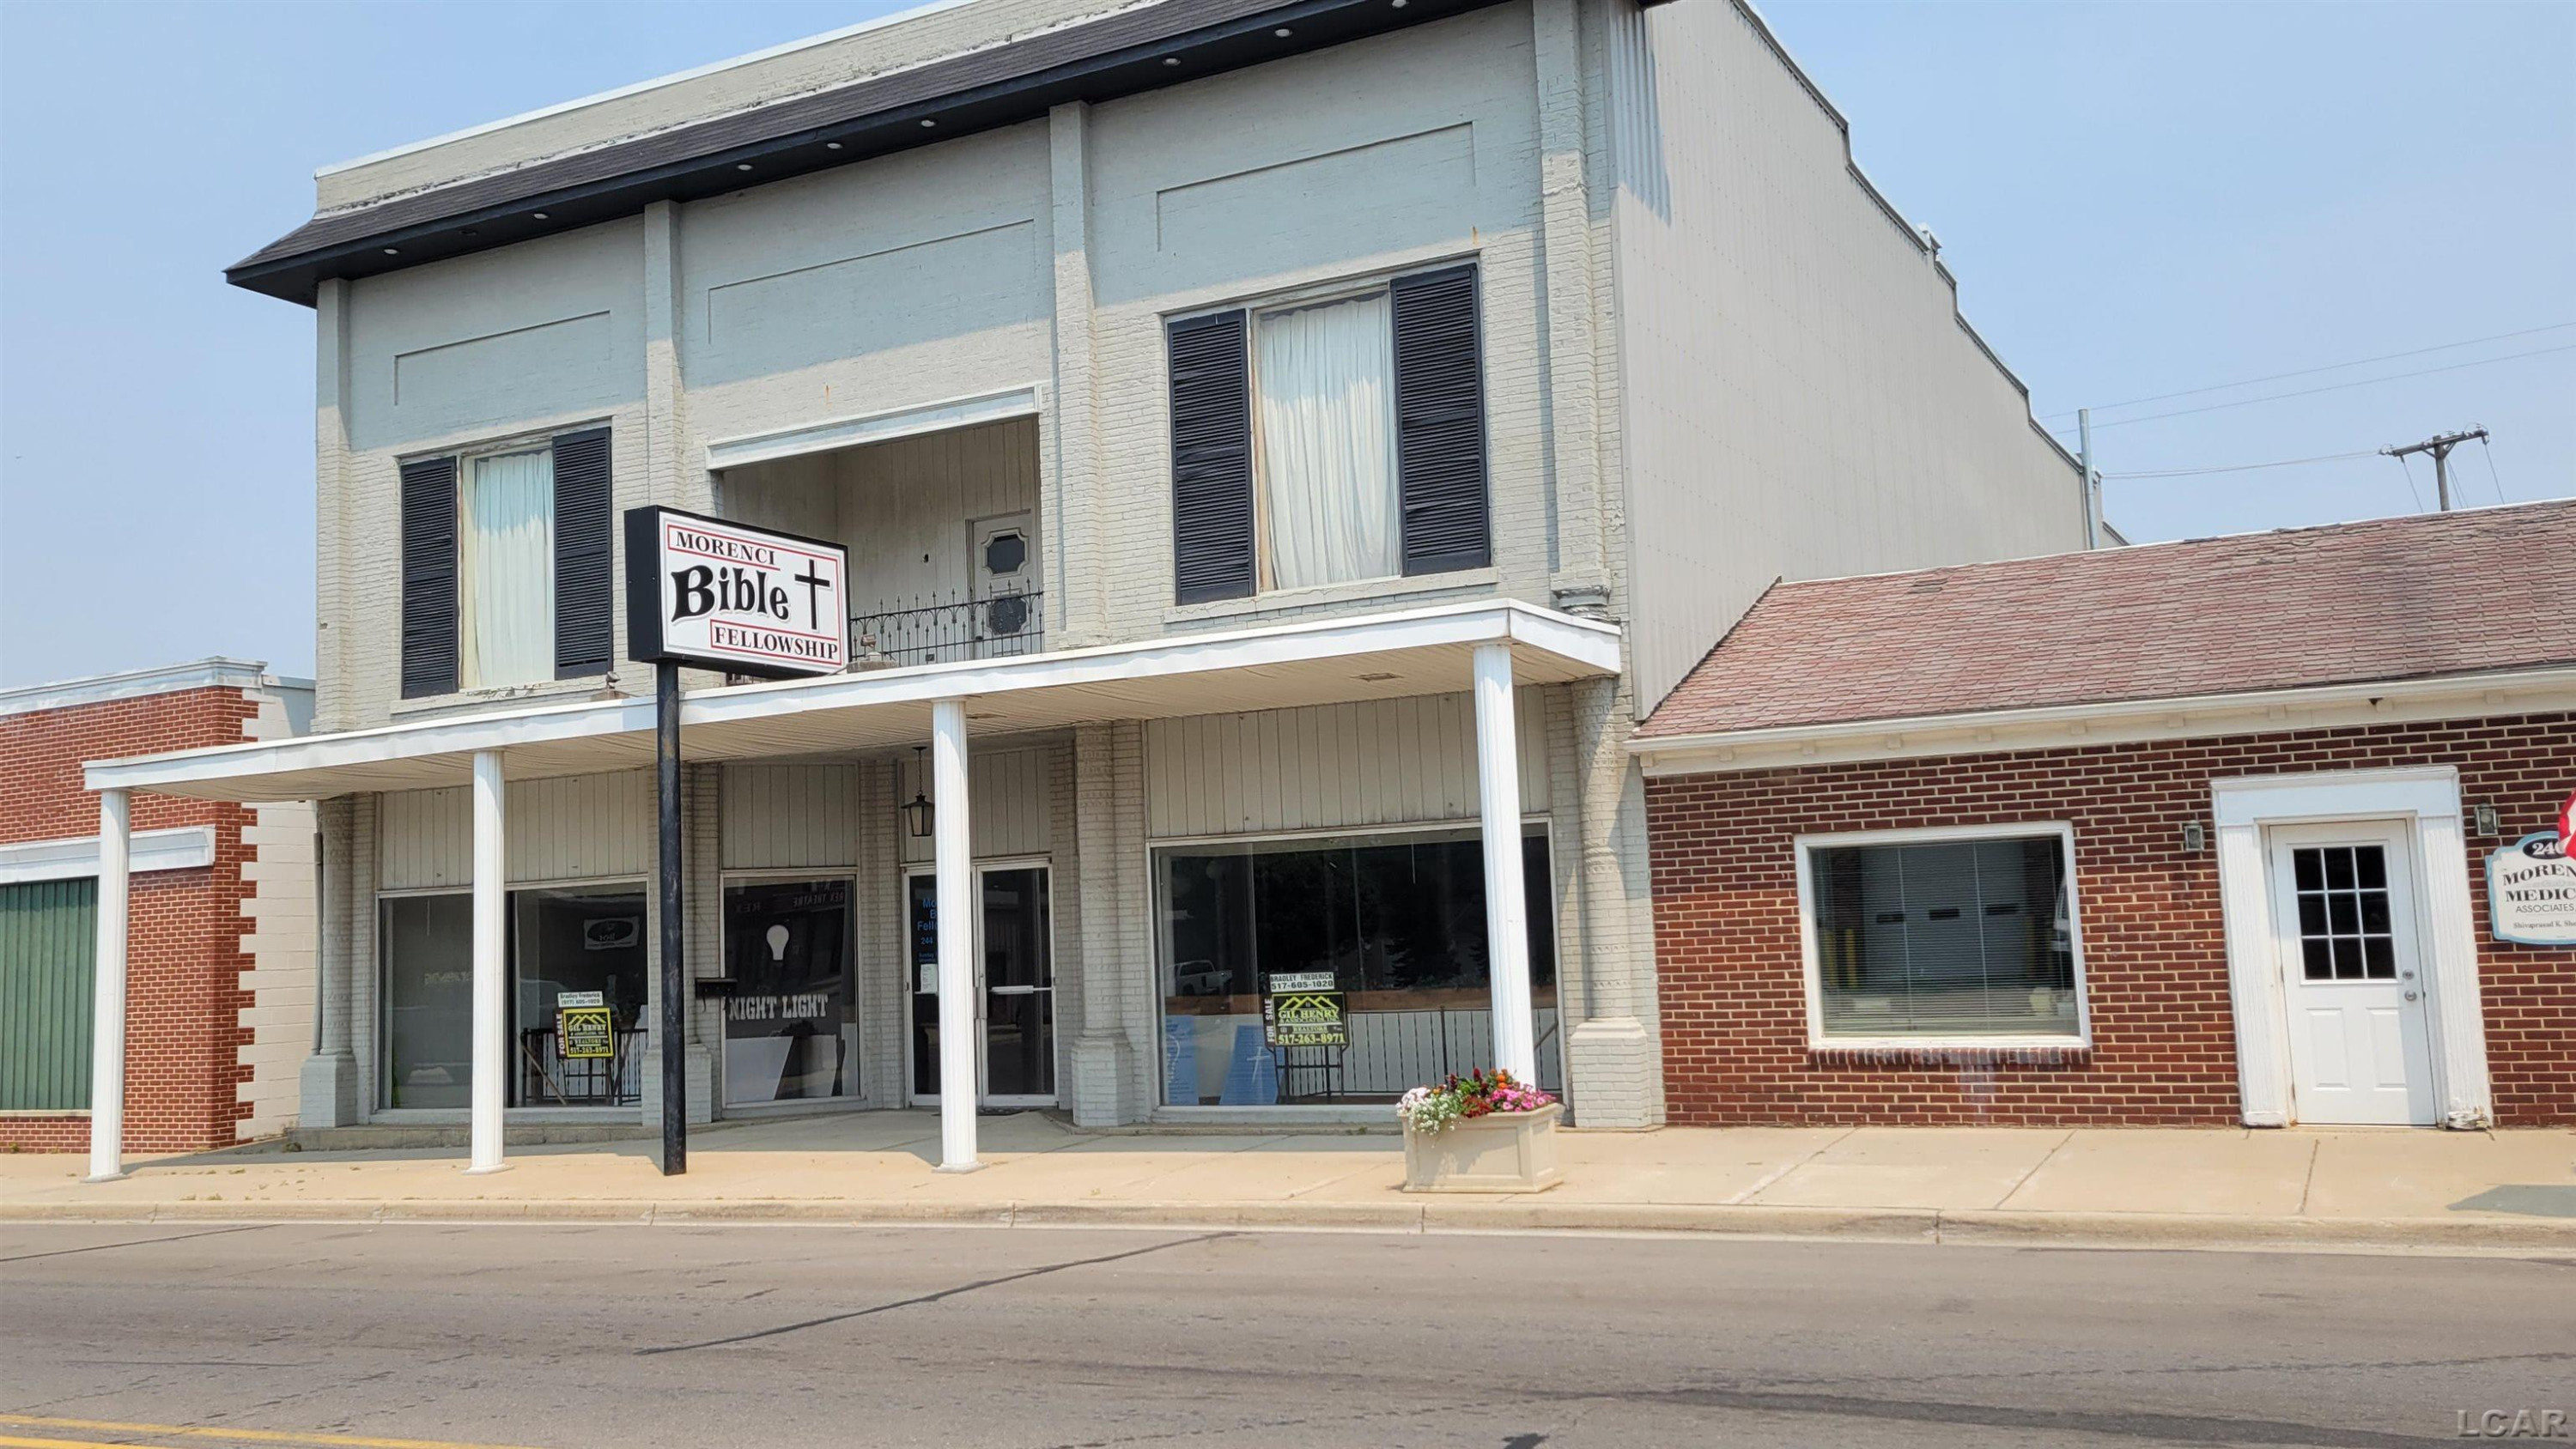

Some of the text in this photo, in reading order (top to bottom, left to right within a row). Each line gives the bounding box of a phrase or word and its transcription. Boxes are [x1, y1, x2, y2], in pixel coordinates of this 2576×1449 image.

[676, 530, 775, 566] MORENCI
[671, 564, 789, 622] Bible
[714, 626, 838, 660] FELLOWSHIP
[2506, 888, 2576, 902] MEDIC
[1271, 980, 1334, 990] 517-605-1020
[729, 994, 829, 1021] NIGHT LIGHT
[1278, 1009, 1340, 1019] GIL HENRY
[556, 1014, 564, 1035] SALE
[1264, 998, 1275, 1042] FOR SALE
[1278, 1033, 1345, 1044] 517-263-8971
